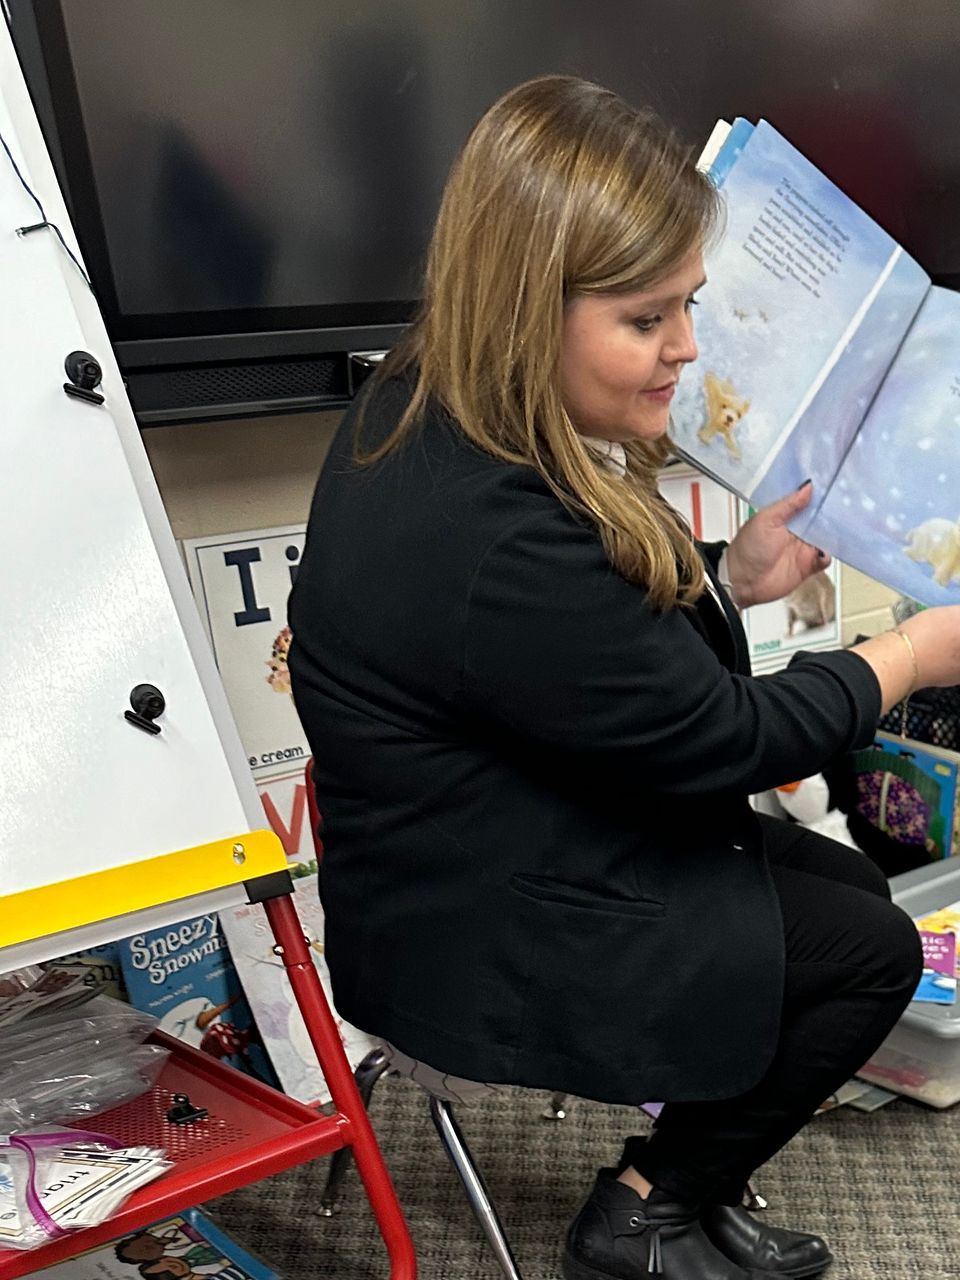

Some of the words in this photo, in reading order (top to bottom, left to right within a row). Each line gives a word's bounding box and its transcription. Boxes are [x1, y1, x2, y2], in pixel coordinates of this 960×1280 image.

[224, 547, 271, 627] I
[262, 746, 304, 764] cream
[130, 912, 218, 969] Sneezy
